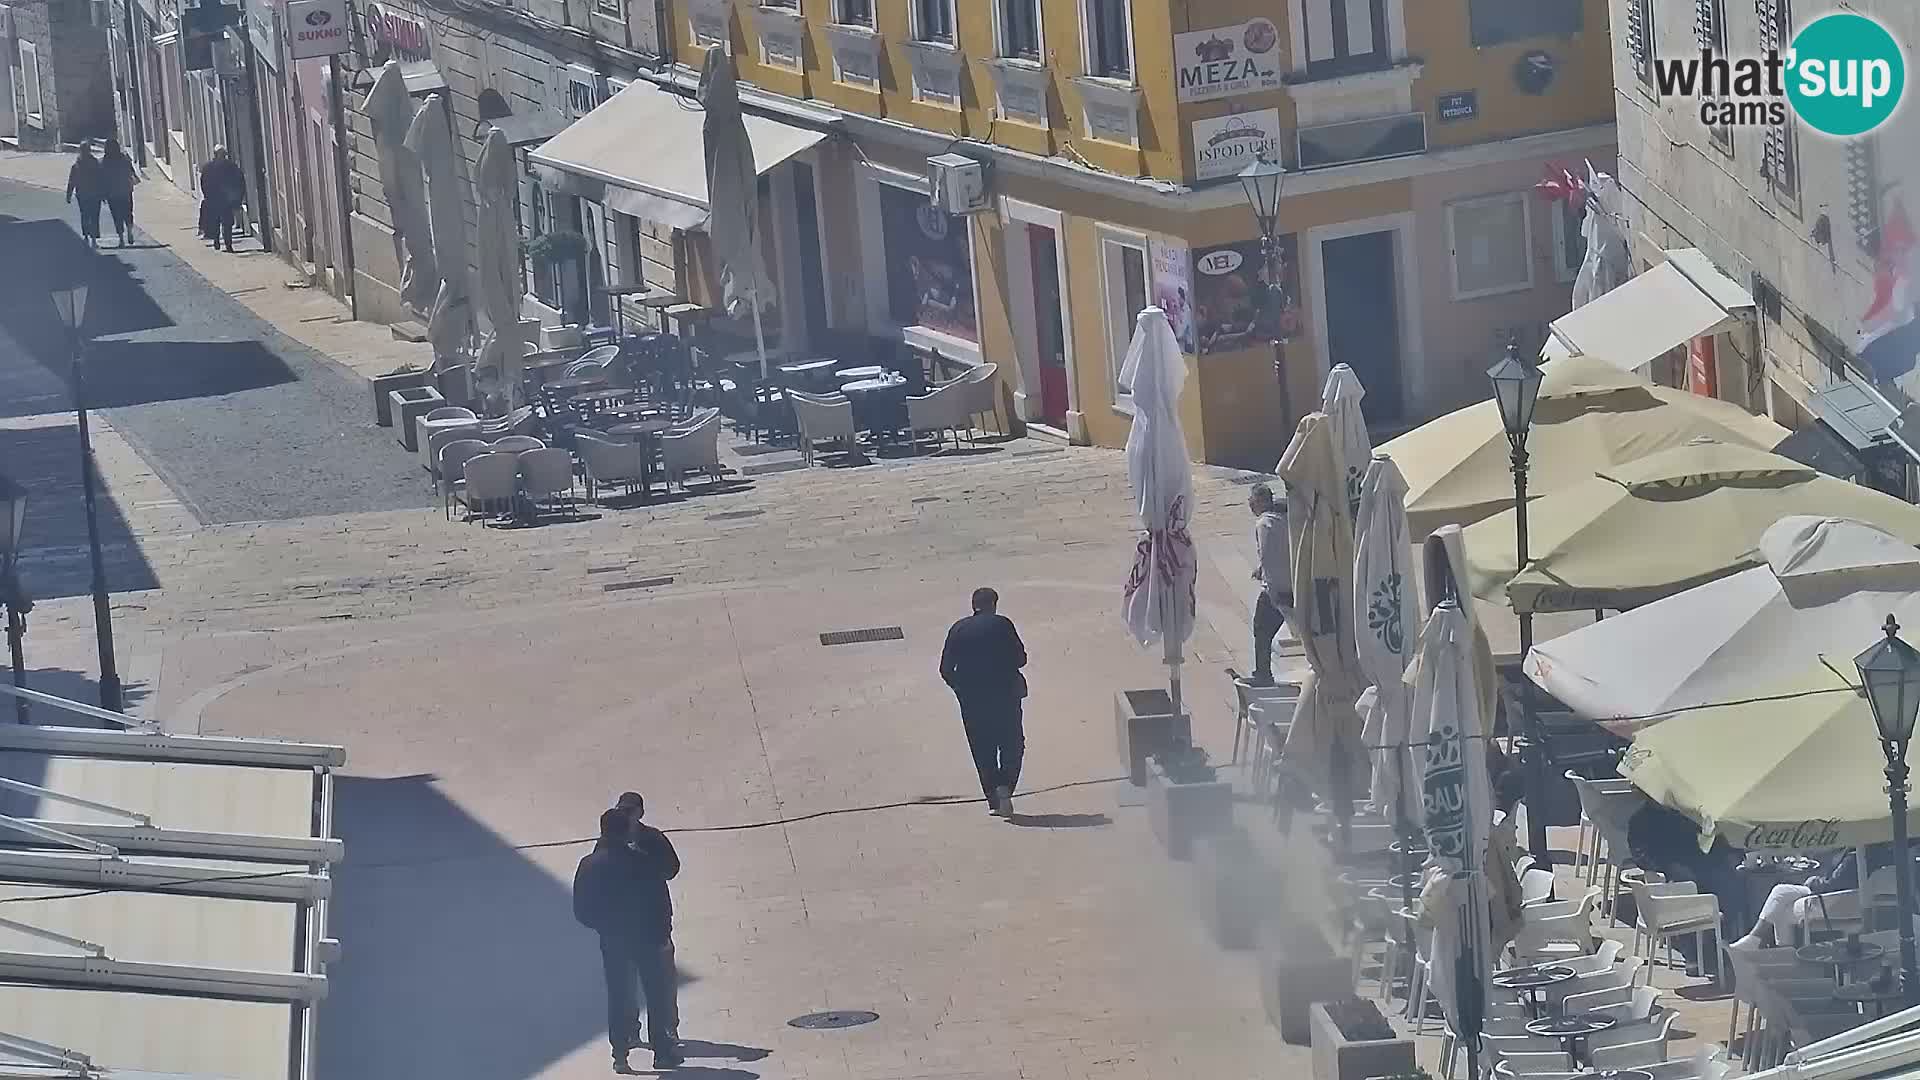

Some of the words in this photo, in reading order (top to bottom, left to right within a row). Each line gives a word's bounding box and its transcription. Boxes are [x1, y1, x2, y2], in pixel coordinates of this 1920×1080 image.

[298, 27, 342, 41] SUKNO
[1180, 58, 1259, 88] MEZA
[1199, 143, 1244, 161] ISPOD
